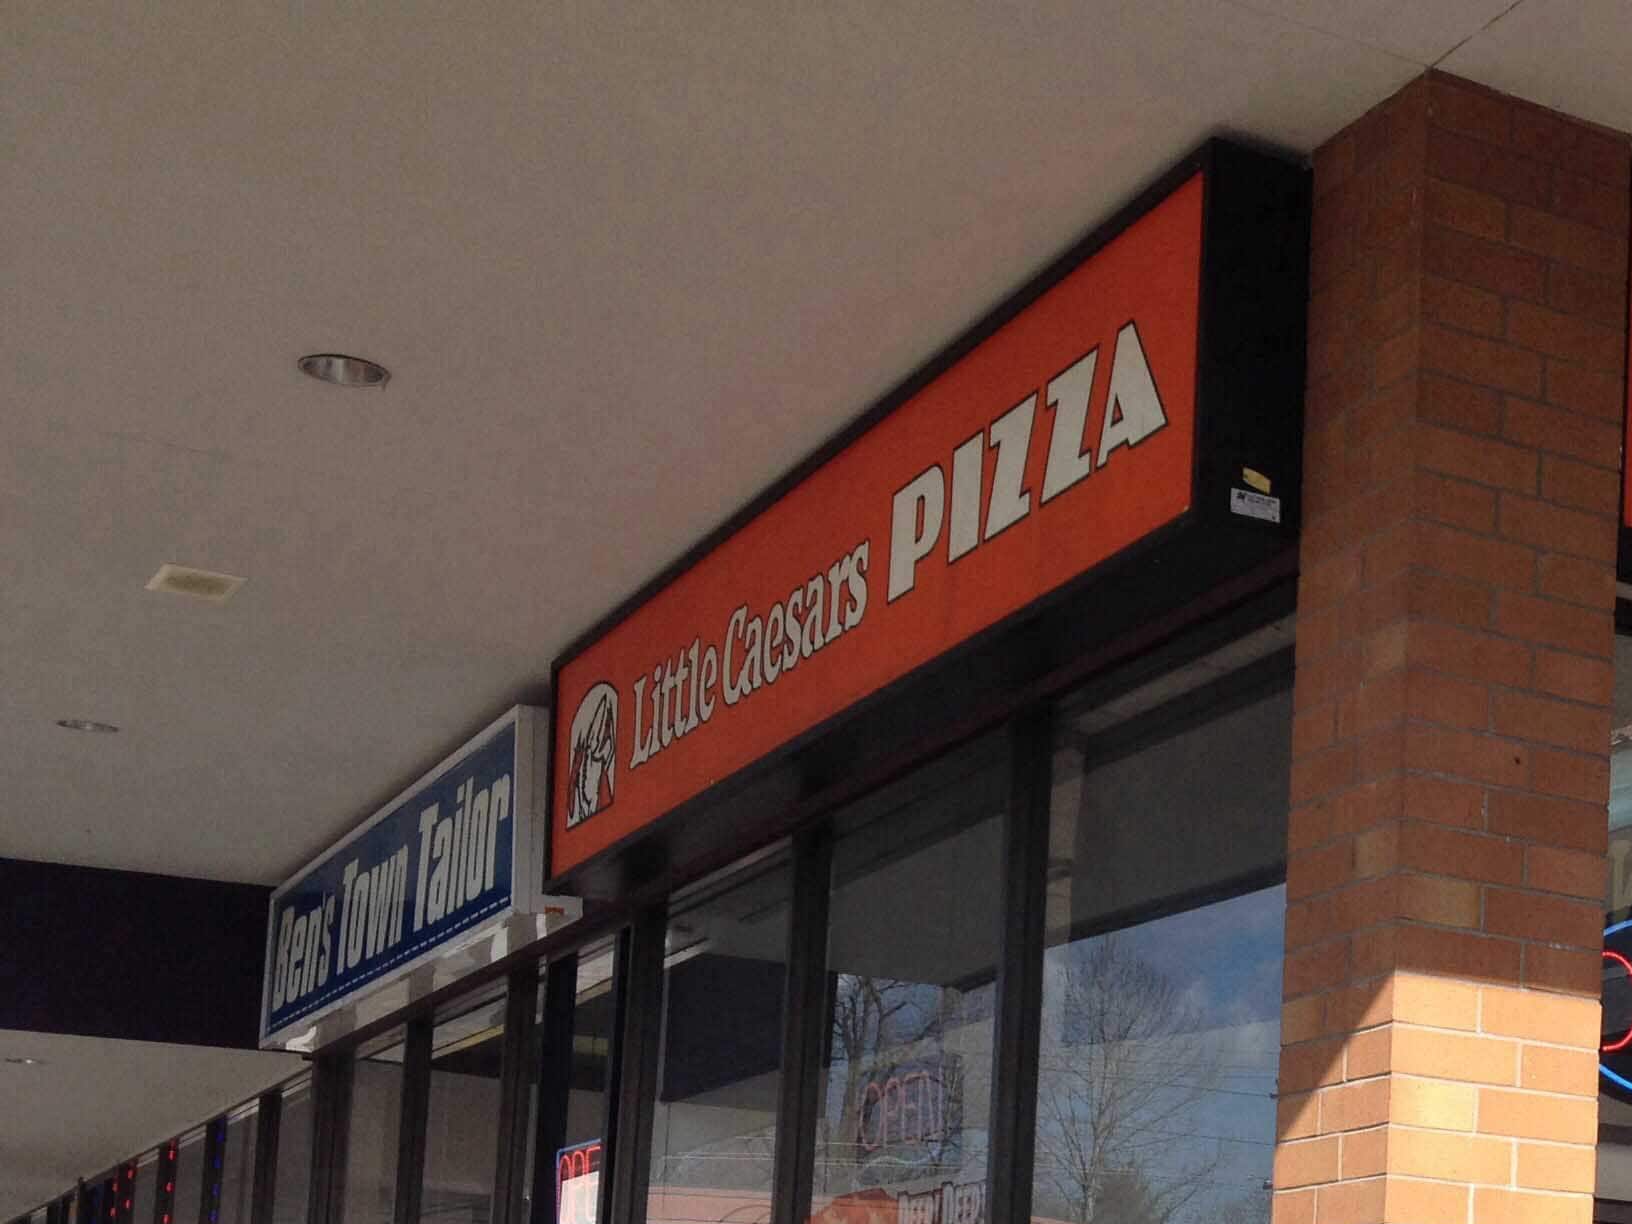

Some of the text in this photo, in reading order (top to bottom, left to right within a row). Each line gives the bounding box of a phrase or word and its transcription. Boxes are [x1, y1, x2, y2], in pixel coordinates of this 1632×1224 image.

[628, 319, 1168, 770] Little Caesars PIZZA
[336, 844, 409, 977] Town
[412, 774, 511, 933] Tailor
